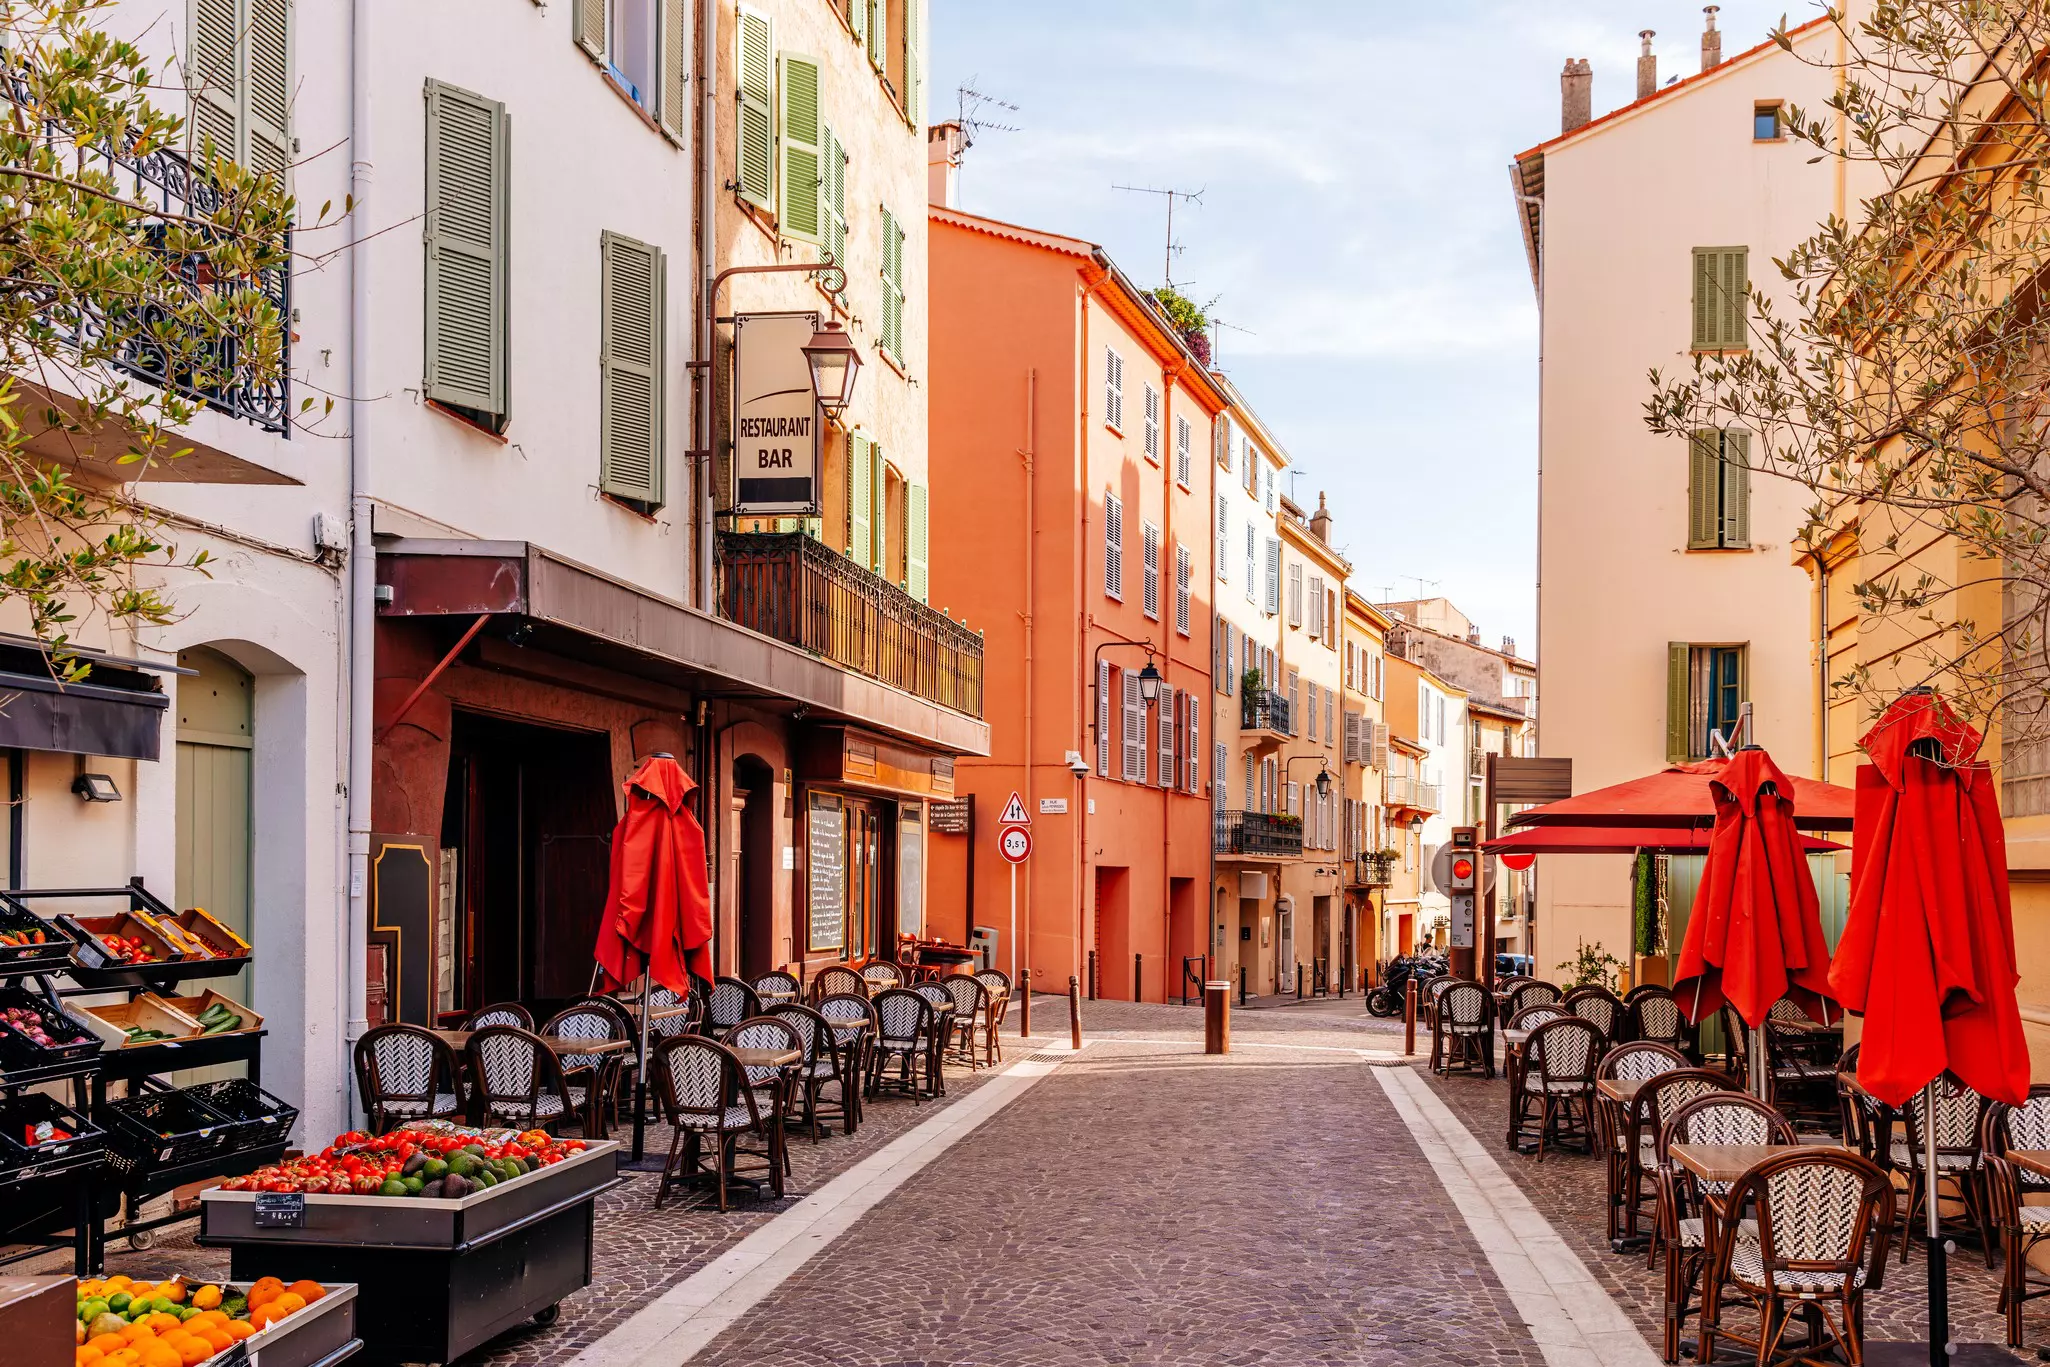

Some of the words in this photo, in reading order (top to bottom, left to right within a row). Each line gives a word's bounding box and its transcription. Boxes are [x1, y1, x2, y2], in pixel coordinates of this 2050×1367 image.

[741, 417, 810, 437] RESTAURANT
[758, 449, 792, 468] BAR
[1006, 839, 1019, 849] 3,5
